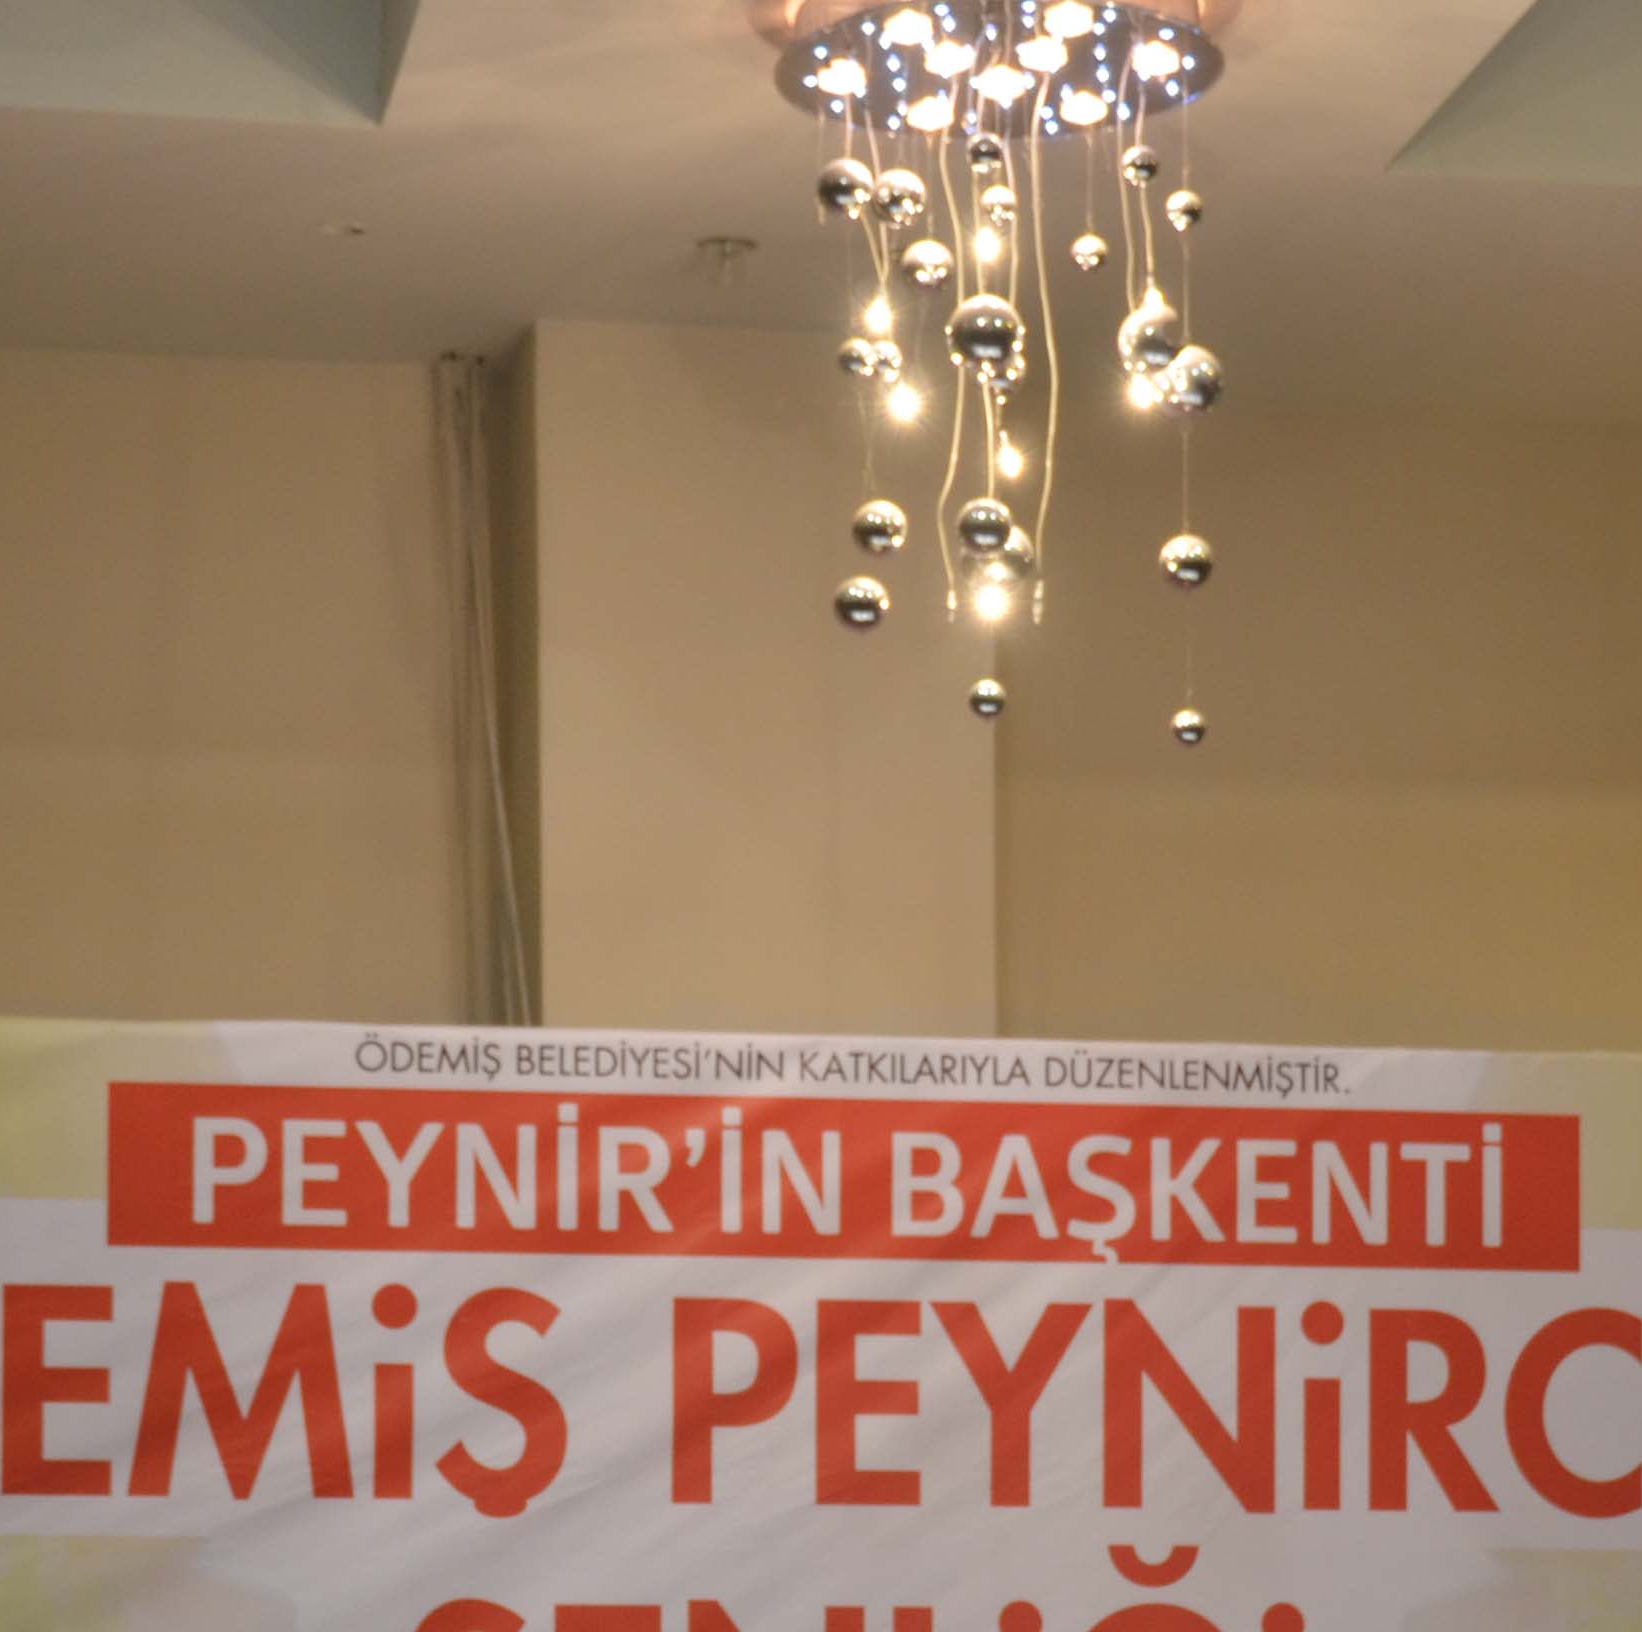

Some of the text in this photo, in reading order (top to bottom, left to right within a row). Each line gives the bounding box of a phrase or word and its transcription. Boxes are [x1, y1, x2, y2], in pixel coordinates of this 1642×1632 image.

[355, 1033, 503, 1081] ÖDEMİŞ
[798, 1050, 1032, 1087] KATKILARIYLA
[890, 1122, 1503, 1264] BAŞKENTİ
